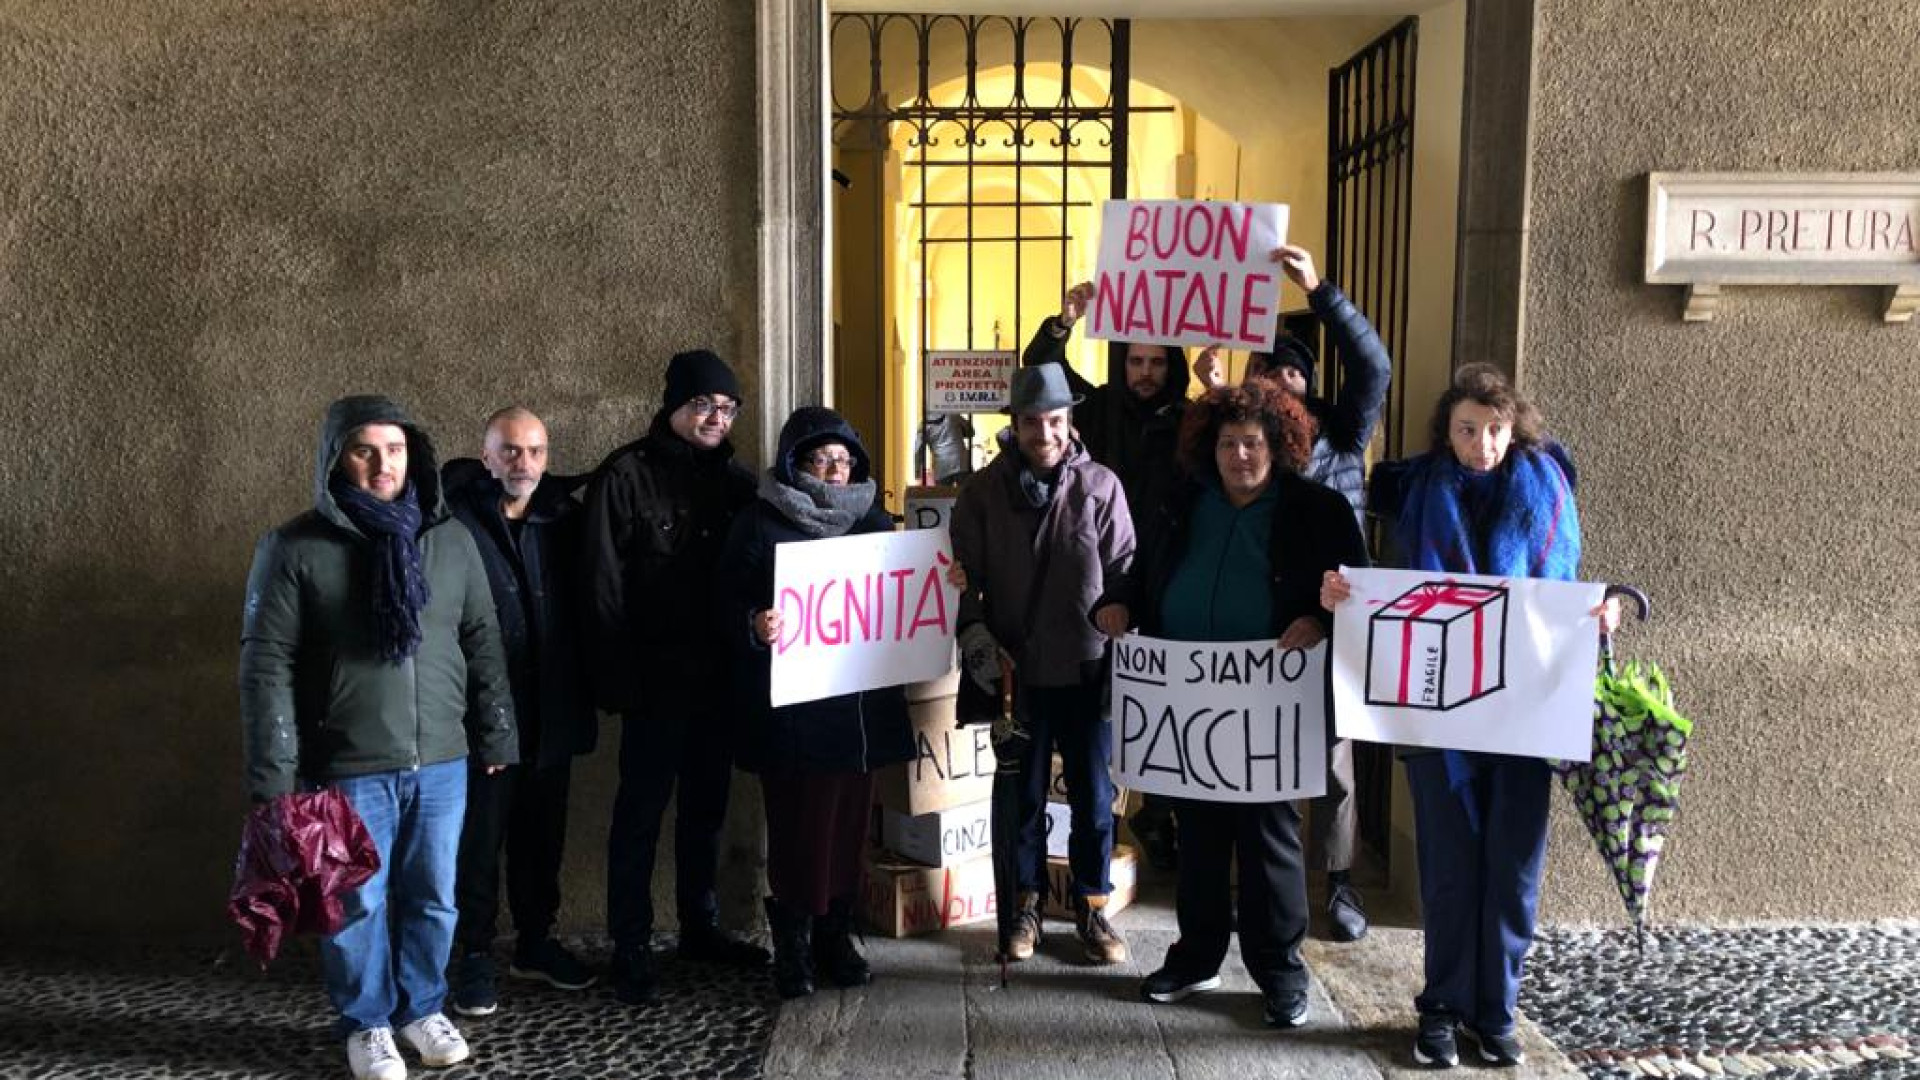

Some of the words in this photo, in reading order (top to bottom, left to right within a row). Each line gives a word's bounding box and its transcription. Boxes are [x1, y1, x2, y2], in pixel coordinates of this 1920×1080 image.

[1125, 204, 1253, 263] BUON
[1690, 209, 1727, 250] R.
[1739, 209, 1915, 253] PRETURA
[1094, 269, 1272, 344] NATALE
[932, 357, 1010, 367] ATTENZIONE
[935, 380, 1007, 390] PROTETTA
[952, 369, 992, 378] AREA
[778, 550, 950, 656] DIGNITÀ
[1116, 642, 1167, 676] NON
[1185, 646, 1308, 684] SIAMO
[1421, 646, 1439, 702] FRAGILE
[1120, 693, 1301, 792] PACCHI
